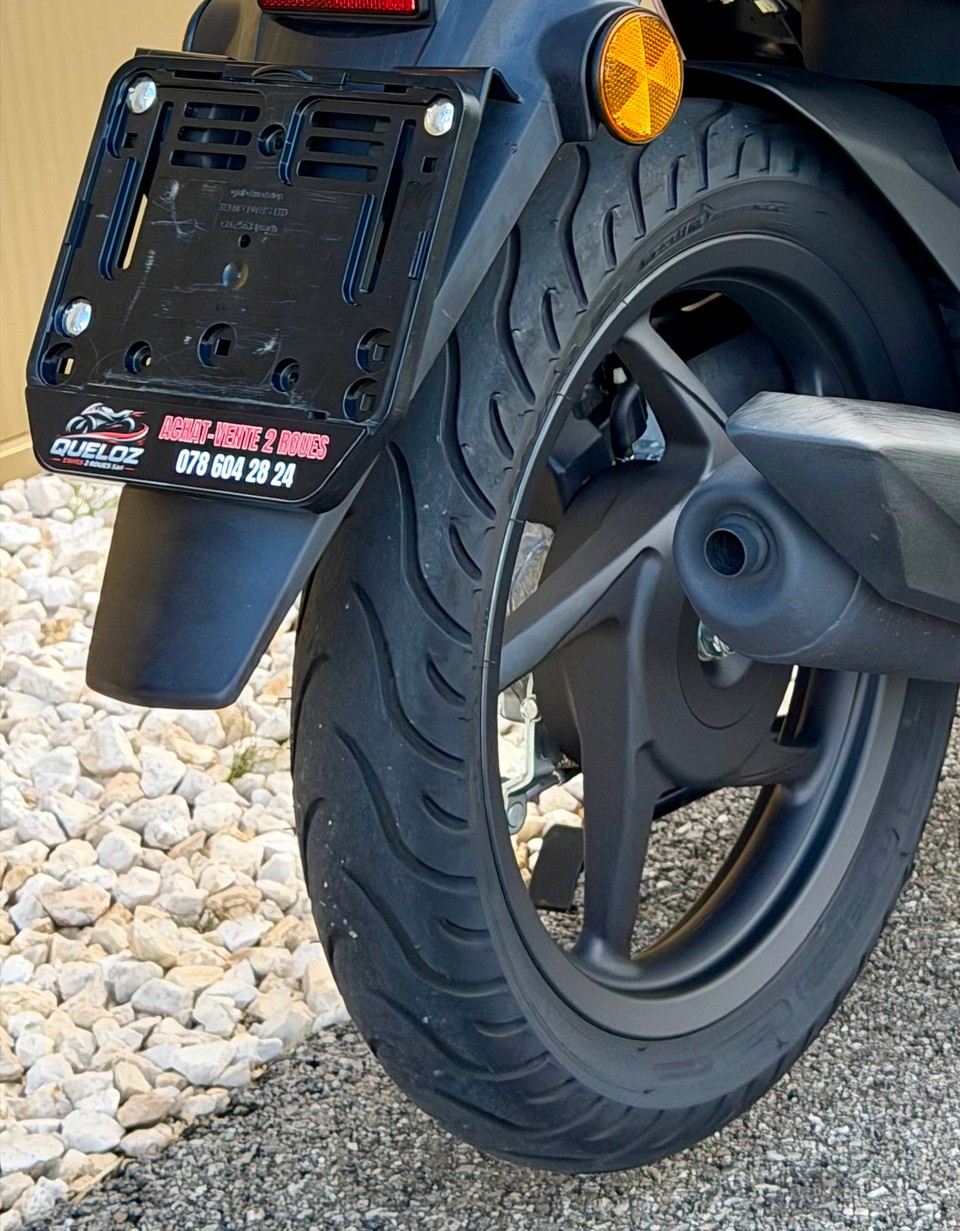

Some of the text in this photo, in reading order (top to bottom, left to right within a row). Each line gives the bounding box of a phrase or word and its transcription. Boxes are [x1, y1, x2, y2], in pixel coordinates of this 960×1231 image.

[49, 438, 145, 465] QUELOZ
[158, 415, 330, 460] ACHAT-VENTE 2 ROUES
[175, 449, 297, 489] 078 604 28 24
